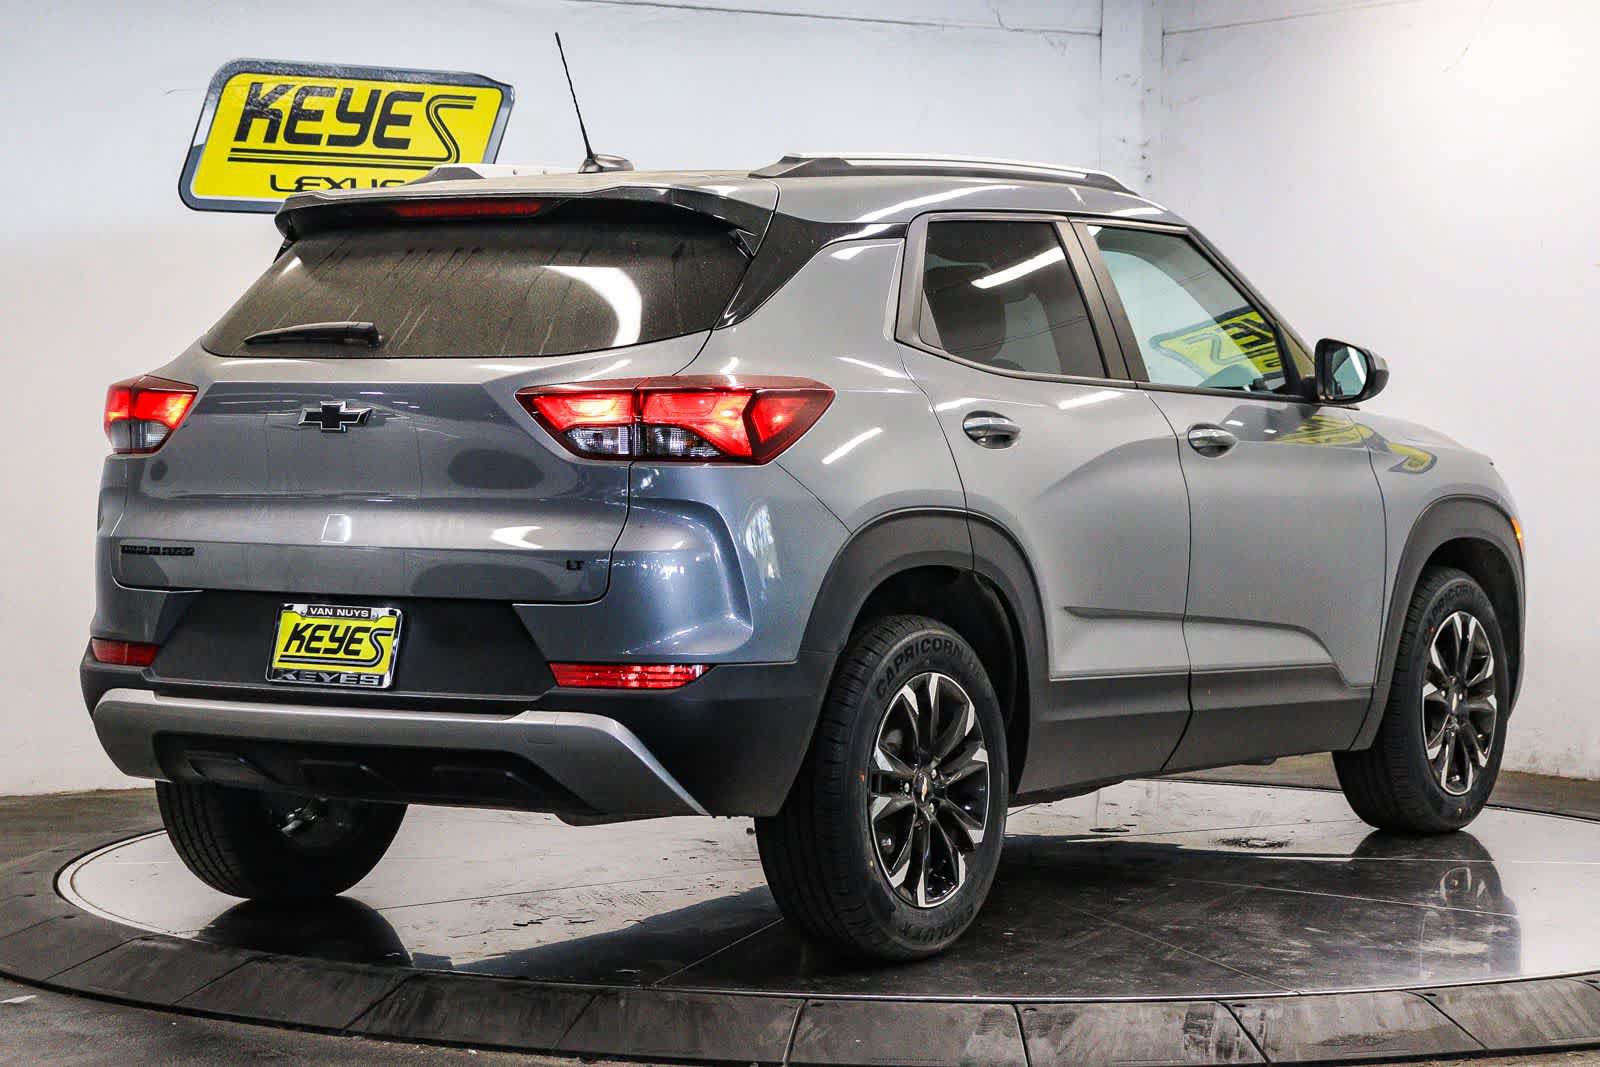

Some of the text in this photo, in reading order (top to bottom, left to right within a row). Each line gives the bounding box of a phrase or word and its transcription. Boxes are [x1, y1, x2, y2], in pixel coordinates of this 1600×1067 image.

[227, 82, 477, 170] KEYES
[566, 560, 585, 570] LT
[310, 607, 369, 617] VAN NUYS
[279, 622, 394, 667] KEYES
[278, 670, 380, 685] KEYES
[876, 638, 963, 698] CAPRICORN
